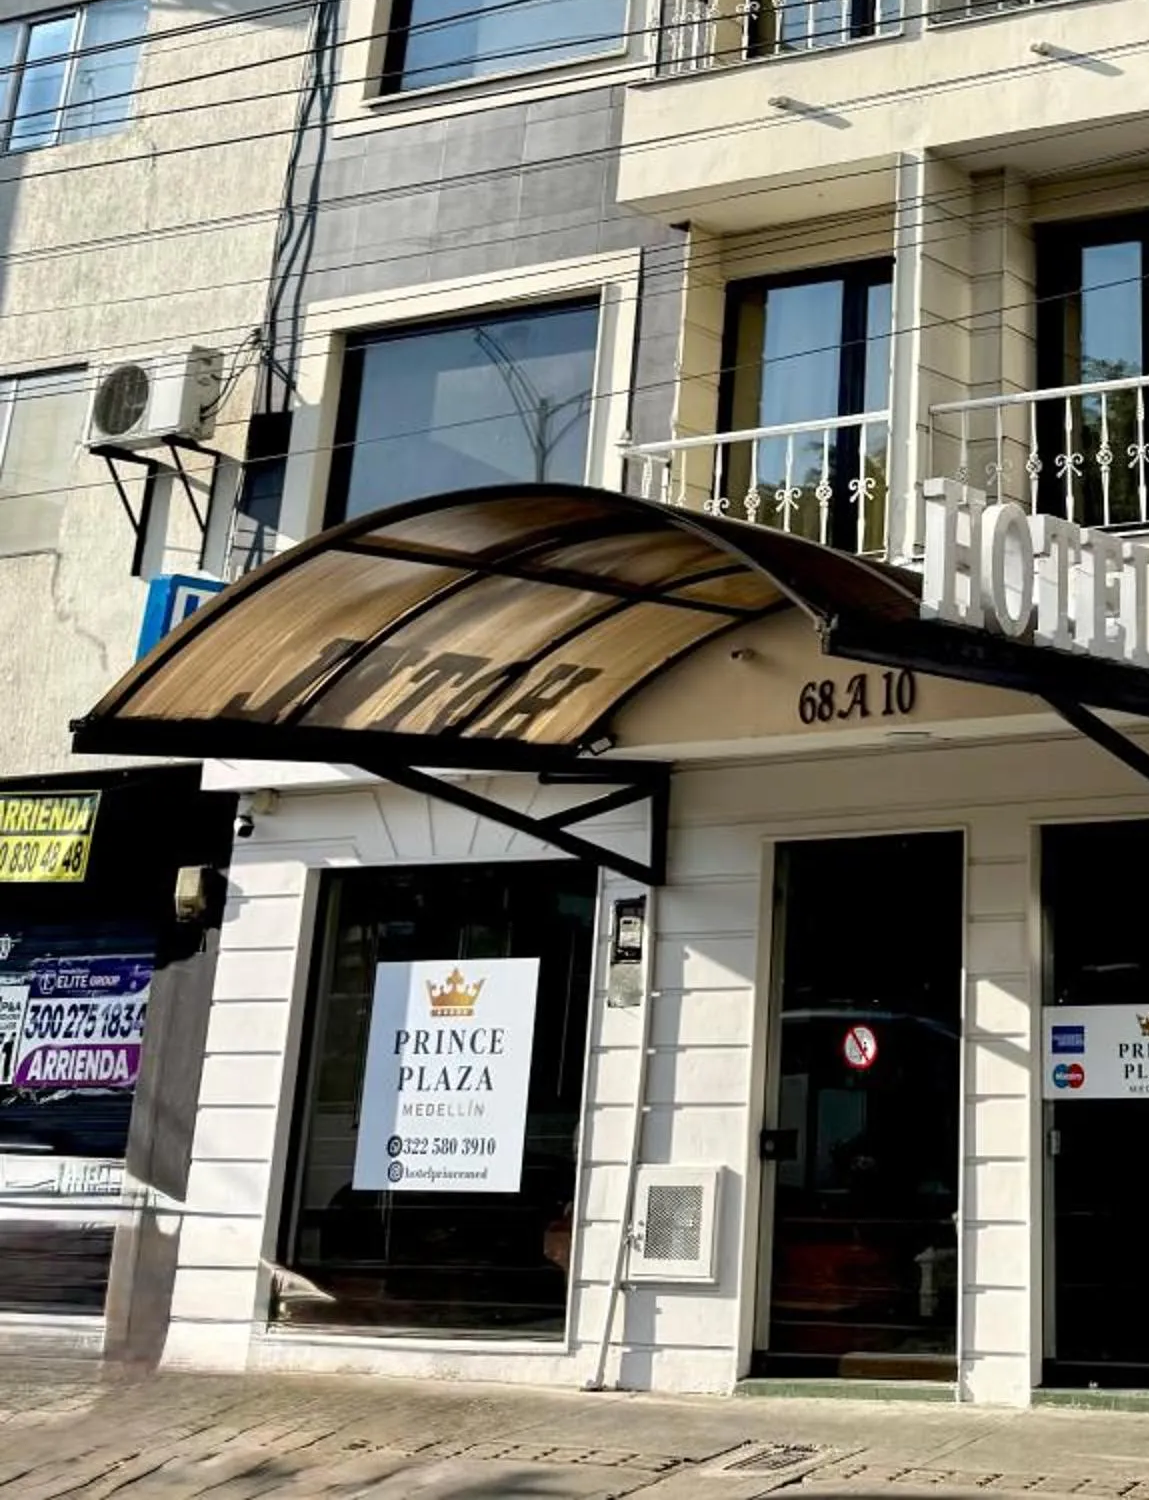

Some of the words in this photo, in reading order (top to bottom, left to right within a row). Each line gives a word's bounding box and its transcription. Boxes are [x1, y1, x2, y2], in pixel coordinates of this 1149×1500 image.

[881, 665, 917, 716] 10
[62, 840, 83, 873] 48
[24, 1003, 64, 1039] 300
[62, 1003, 99, 1039] 275
[393, 1028, 505, 1055] PRINCE
[26, 1049, 130, 1081] ARRIENDA
[397, 1065, 494, 1091] PLAZA
[402, 1100, 486, 1117] MEDELLÍN
[403, 1137, 429, 1155] 322
[431, 1137, 458, 1155] 580
[461, 1137, 497, 1155] 3910
